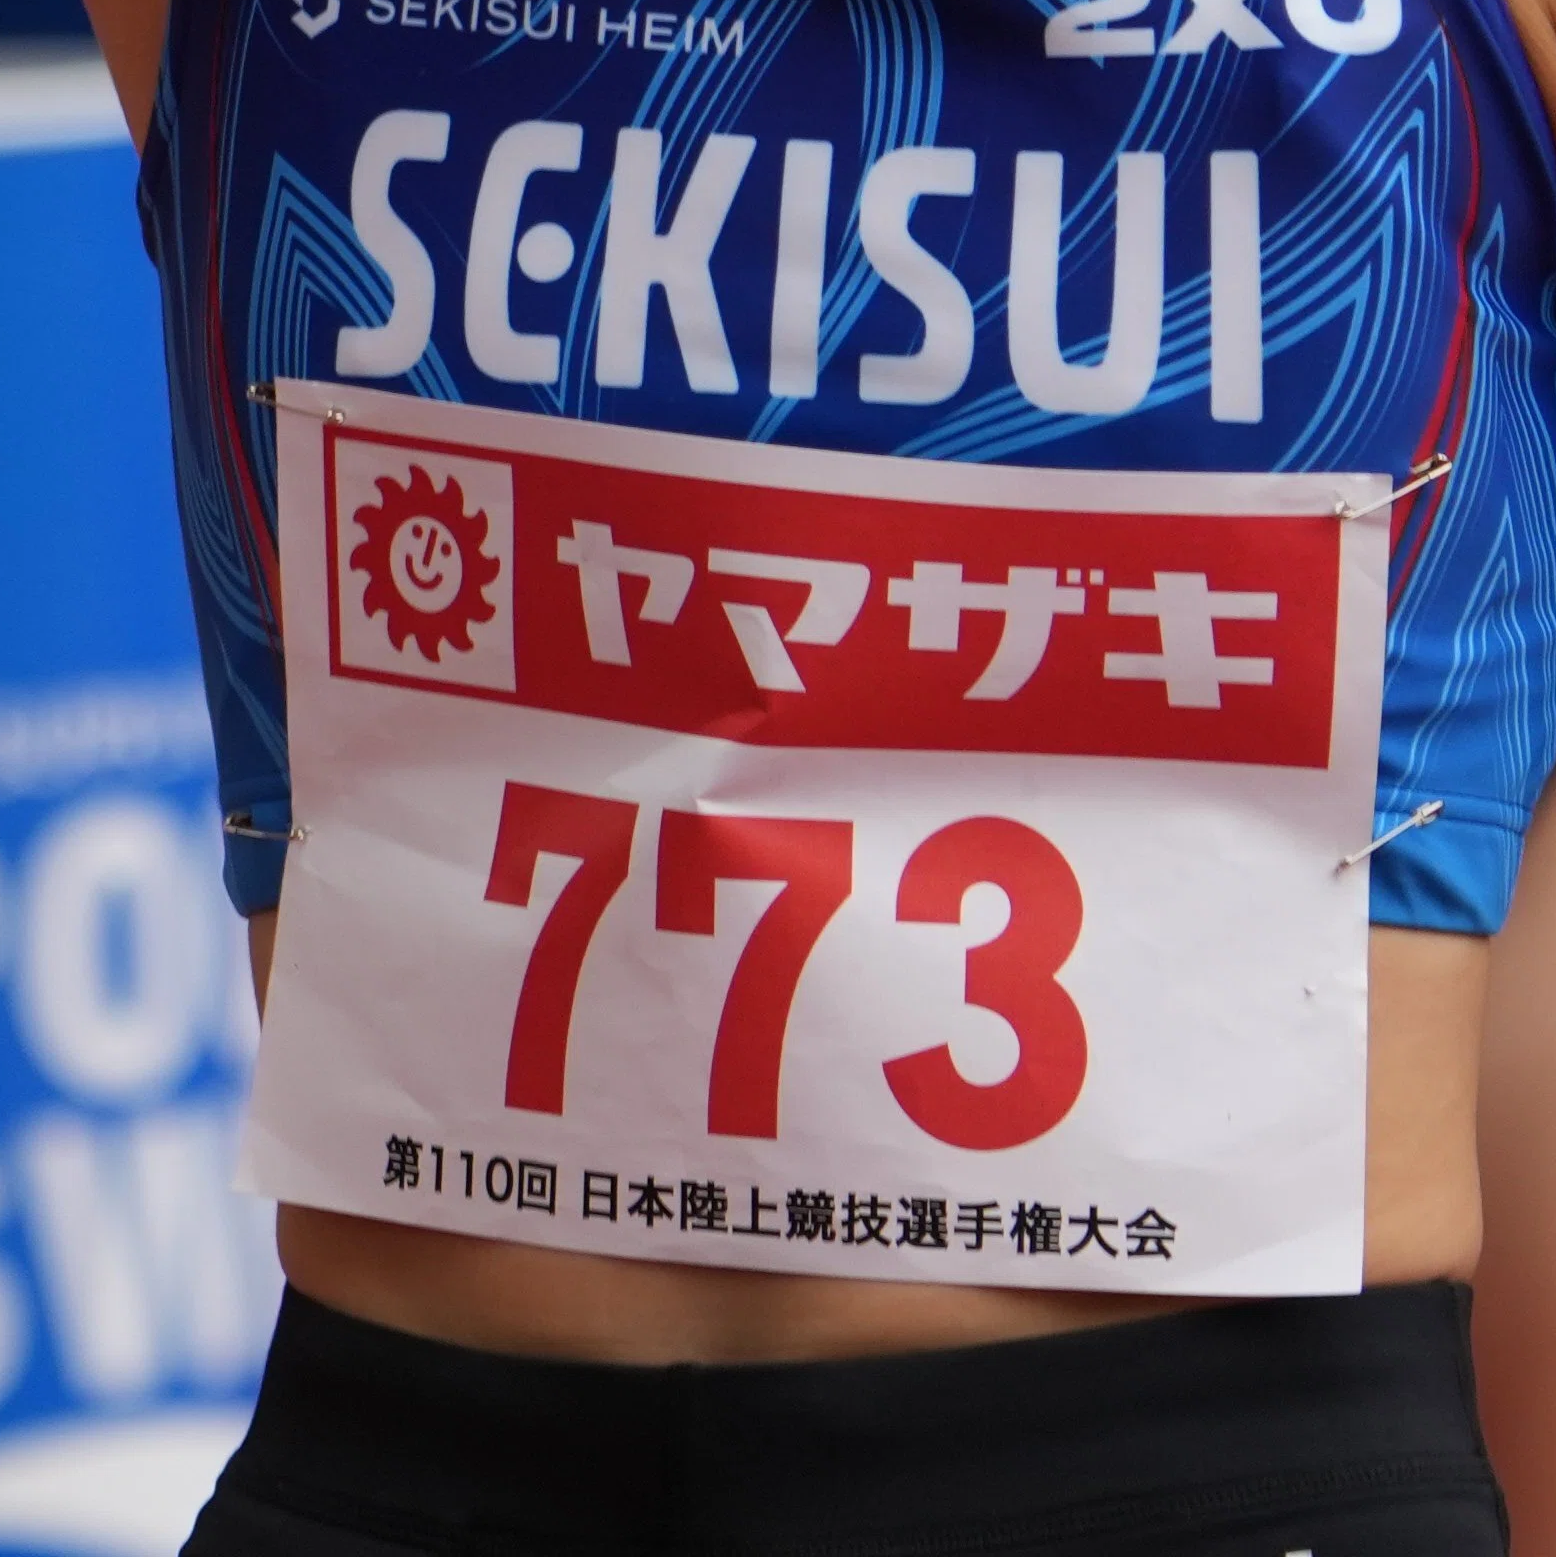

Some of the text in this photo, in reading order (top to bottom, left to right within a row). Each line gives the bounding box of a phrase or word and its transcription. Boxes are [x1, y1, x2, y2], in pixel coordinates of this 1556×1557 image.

[598, 5, 746, 58] HEIM
[334, 109, 1266, 425] SEKISUI
[556, 517, 1279, 710] ヤマザキ
[482, 780, 1090, 1152] 773
[383, 1133, 1178, 1262] 第110回 日本陸上競技選手権大会
